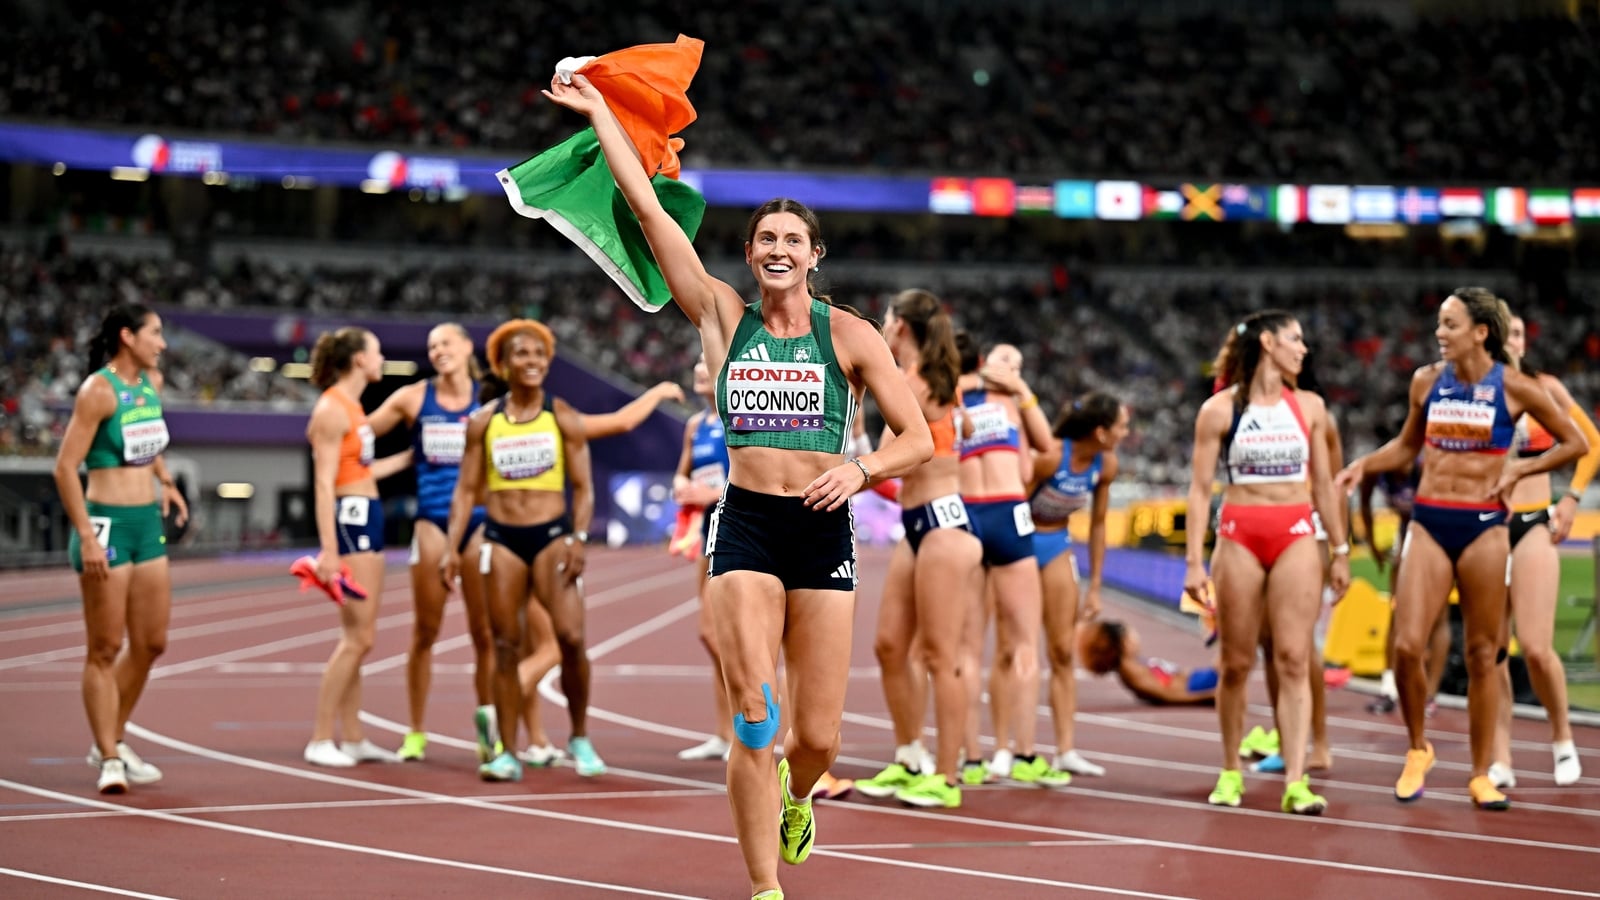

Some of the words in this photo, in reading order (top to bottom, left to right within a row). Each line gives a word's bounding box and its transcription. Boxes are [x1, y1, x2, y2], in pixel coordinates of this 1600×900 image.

[728, 368, 822, 383] HONDA
[730, 389, 820, 412] O'CONNOR
[348, 505, 360, 518] 6
[938, 501, 961, 522] 10
